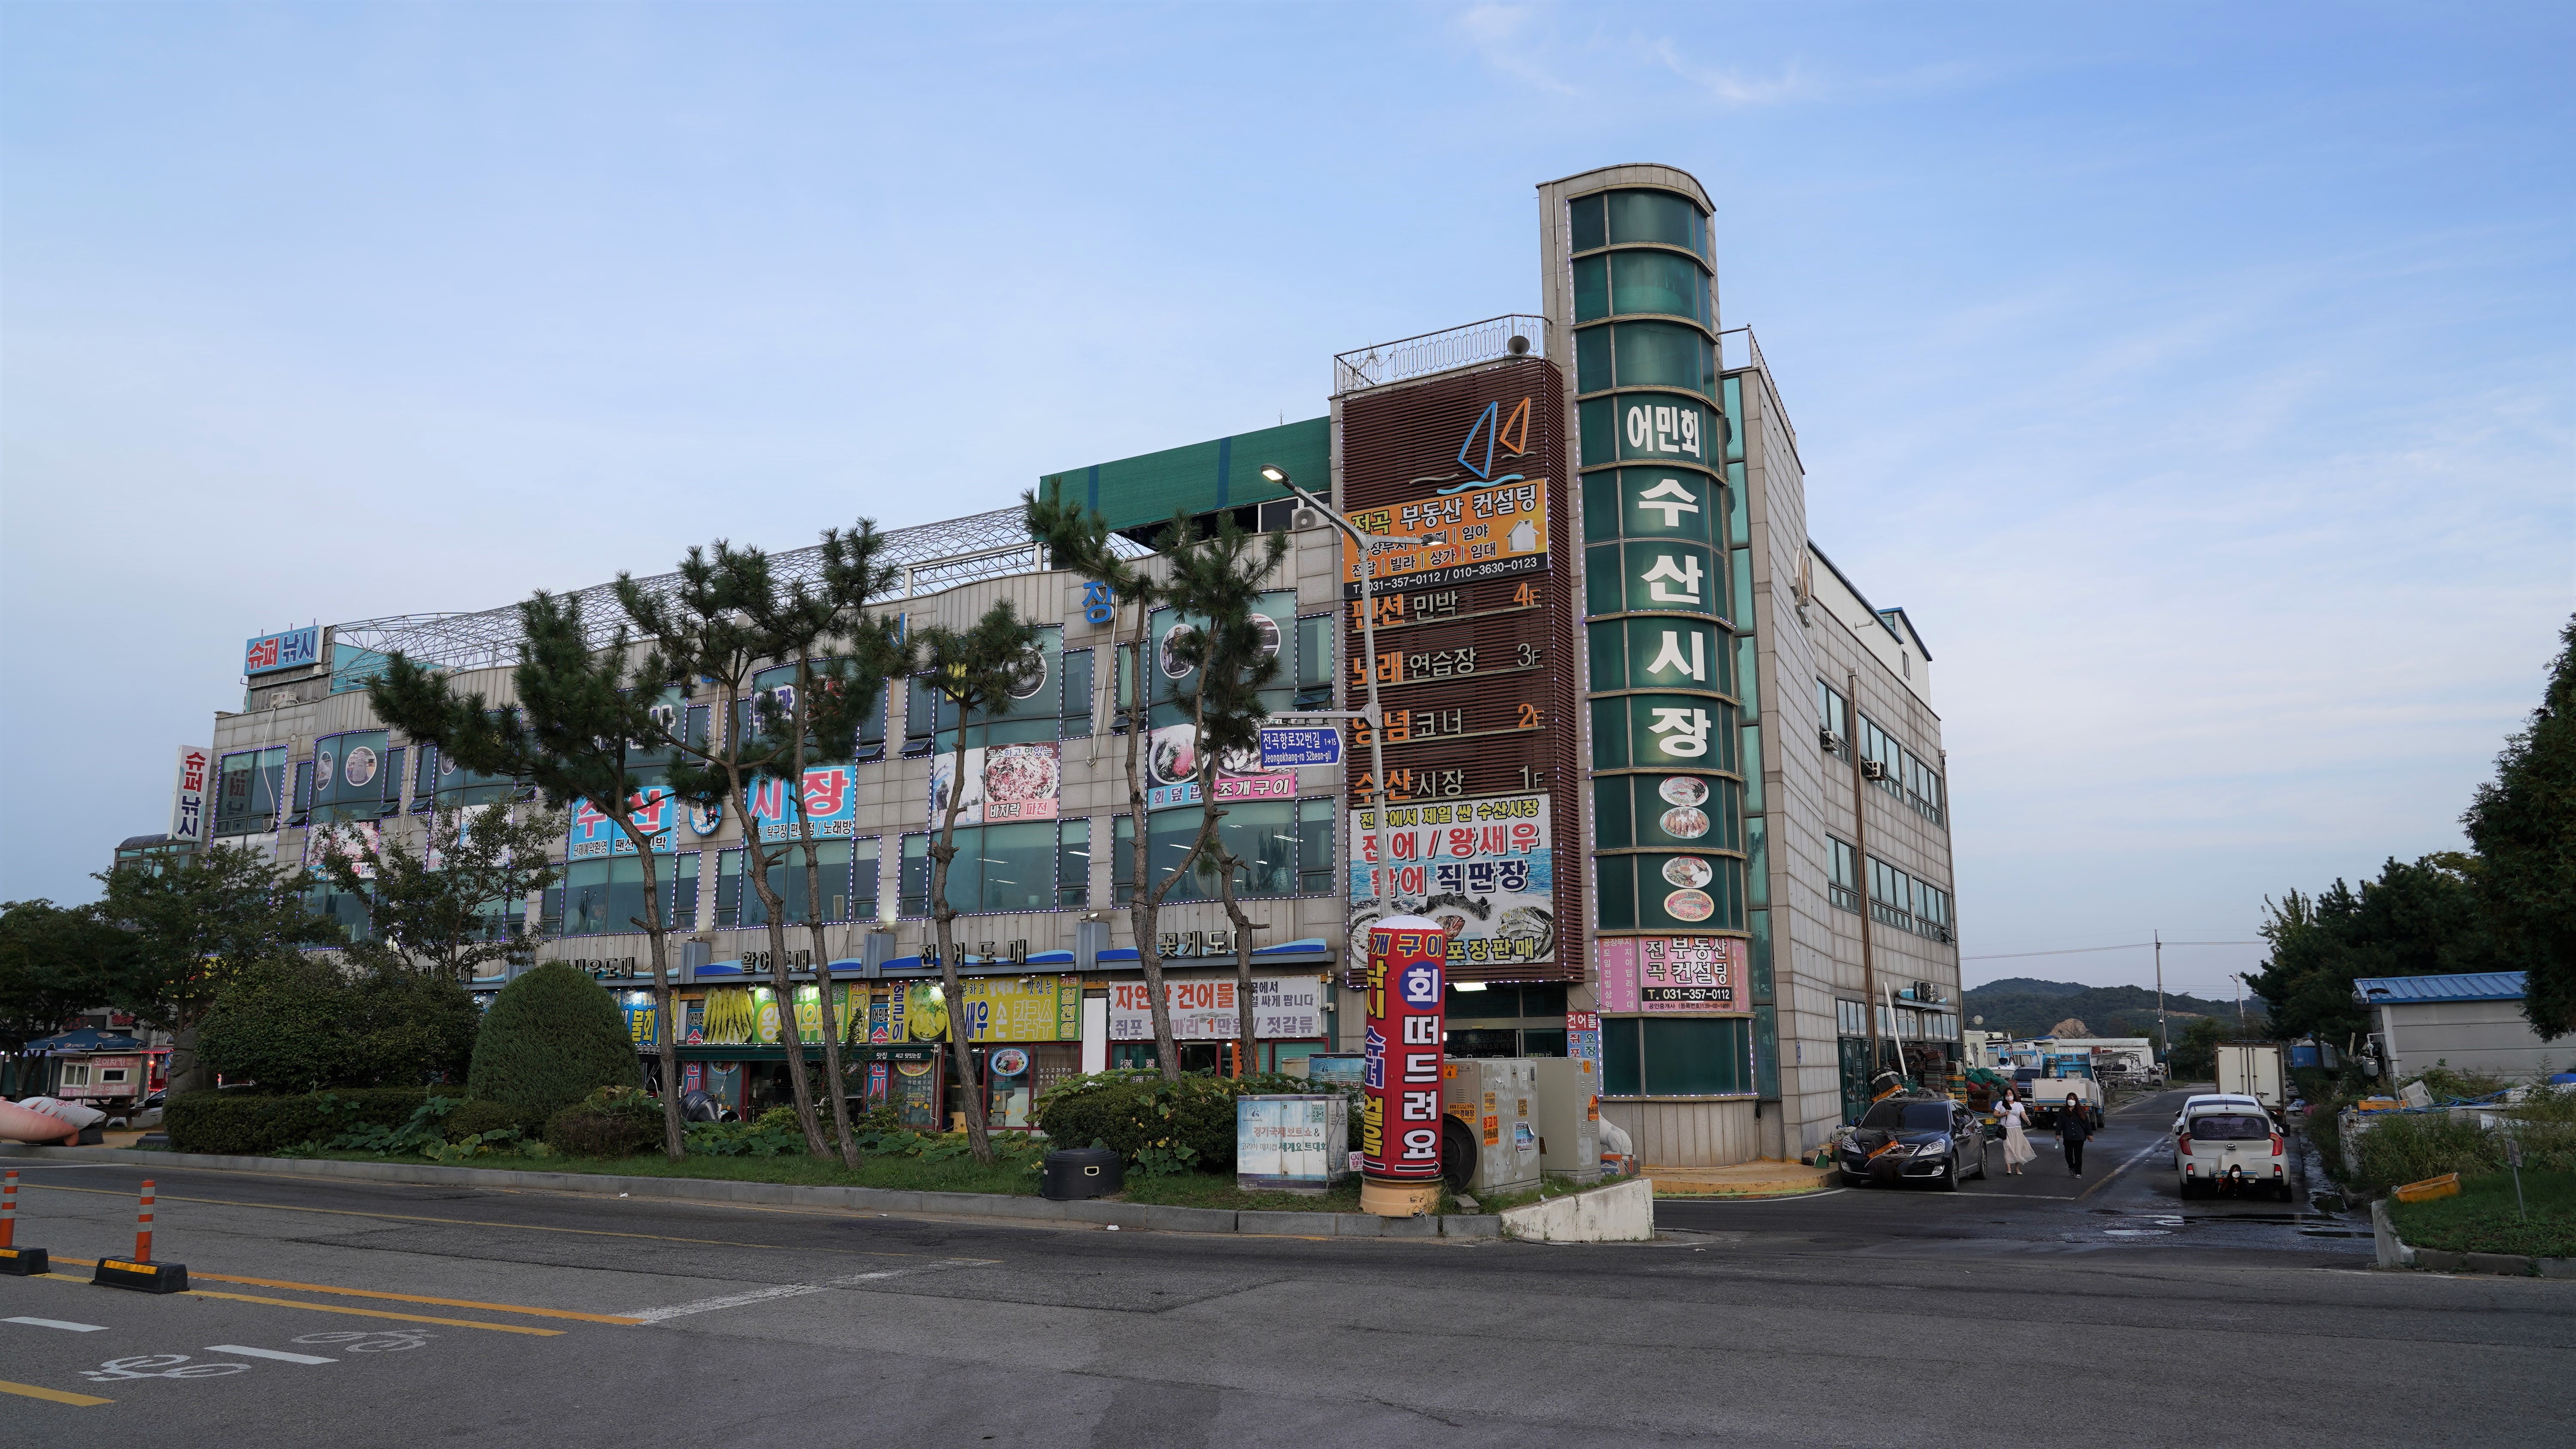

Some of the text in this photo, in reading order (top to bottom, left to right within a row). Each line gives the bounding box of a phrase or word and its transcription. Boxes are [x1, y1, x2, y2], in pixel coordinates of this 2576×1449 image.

[1627, 404, 1701, 458] 어민회
[1351, 484, 1537, 535] 전곡 부동산 컨설팅
[1461, 523, 1488, 540] 임야
[1390, 555, 1416, 572] 빌라
[1430, 548, 1456, 565] 상가
[1470, 542, 1496, 559] 임대
[1453, 557, 1537, 579] 010-3630-0123
[1082, 582, 1115, 624] 장
[1414, 590, 1458, 621] 민박
[1513, 582, 1541, 606] 4F
[1639, 479, 1711, 757] 수산시장
[247, 628, 316, 670] 슈퍼 낚시
[1352, 643, 1541, 685] 노래 연습장 3F
[1416, 709, 1461, 737] 코너
[1518, 703, 1544, 728] 2F
[987, 746, 1053, 759] 고소하고 맛있는
[1263, 732, 1320, 750] 전곡항로32번길
[1264, 750, 1332, 764] Jeongokhang-ro 32beon-gil
[177, 751, 206, 837] 슈퍼 낚시
[750, 769, 850, 820] 시장
[1154, 784, 1202, 805] 회덮밥
[1218, 779, 1289, 797] 조개구이
[1354, 765, 1543, 803] 수산 시장 1F
[990, 801, 1048, 818] 바지락 파전
[1360, 798, 1539, 830] 전에서 제일 싼 수산시장
[767, 825, 787, 839] 탁구장
[823, 820, 852, 835] 노래방
[1449, 822, 1540, 858] 왕새우
[573, 840, 607, 858] 단체예약환영
[1437, 860, 1529, 894] 직판장
[1446, 936, 1536, 960] 포장판매
[1603, 938, 1631, 947] 공장부지
[1670, 937, 1728, 960] 부동산
[559, 957, 634, 979] 새우도매
[741, 949, 809, 973] 활어매
[1671, 961, 1728, 985] 컨설팅
[852, 983, 866, 991] 가격
[1027, 979, 1053, 996] 맛있는
[1060, 977, 1077, 985] 가격
[1407, 968, 1438, 1002] 회
[1178, 983, 1234, 1009] 건어물
[1261, 994, 1280, 1007] 싸게
[1663, 988, 1730, 1000] 031-357-0112
[892, 984, 905, 1041] 얼큰이
[965, 999, 1053, 1040] 새우 손 칼국수
[1060, 988, 1076, 1039] 칠천원
[1567, 1014, 1597, 1029] 건어물
[632, 1009, 656, 1042] 물회
[1116, 1019, 1142, 1036] 쥐포
[1267, 1016, 1313, 1034] 젓갈류
[1584, 1033, 1596, 1057] 오징
[94, 1058, 125, 1066] 모이치킨
[1402, 1016, 1439, 1160] 떠드려요
[1314, 1128, 1320, 1137] &
[1483, 1116, 1498, 1128] 중고차
